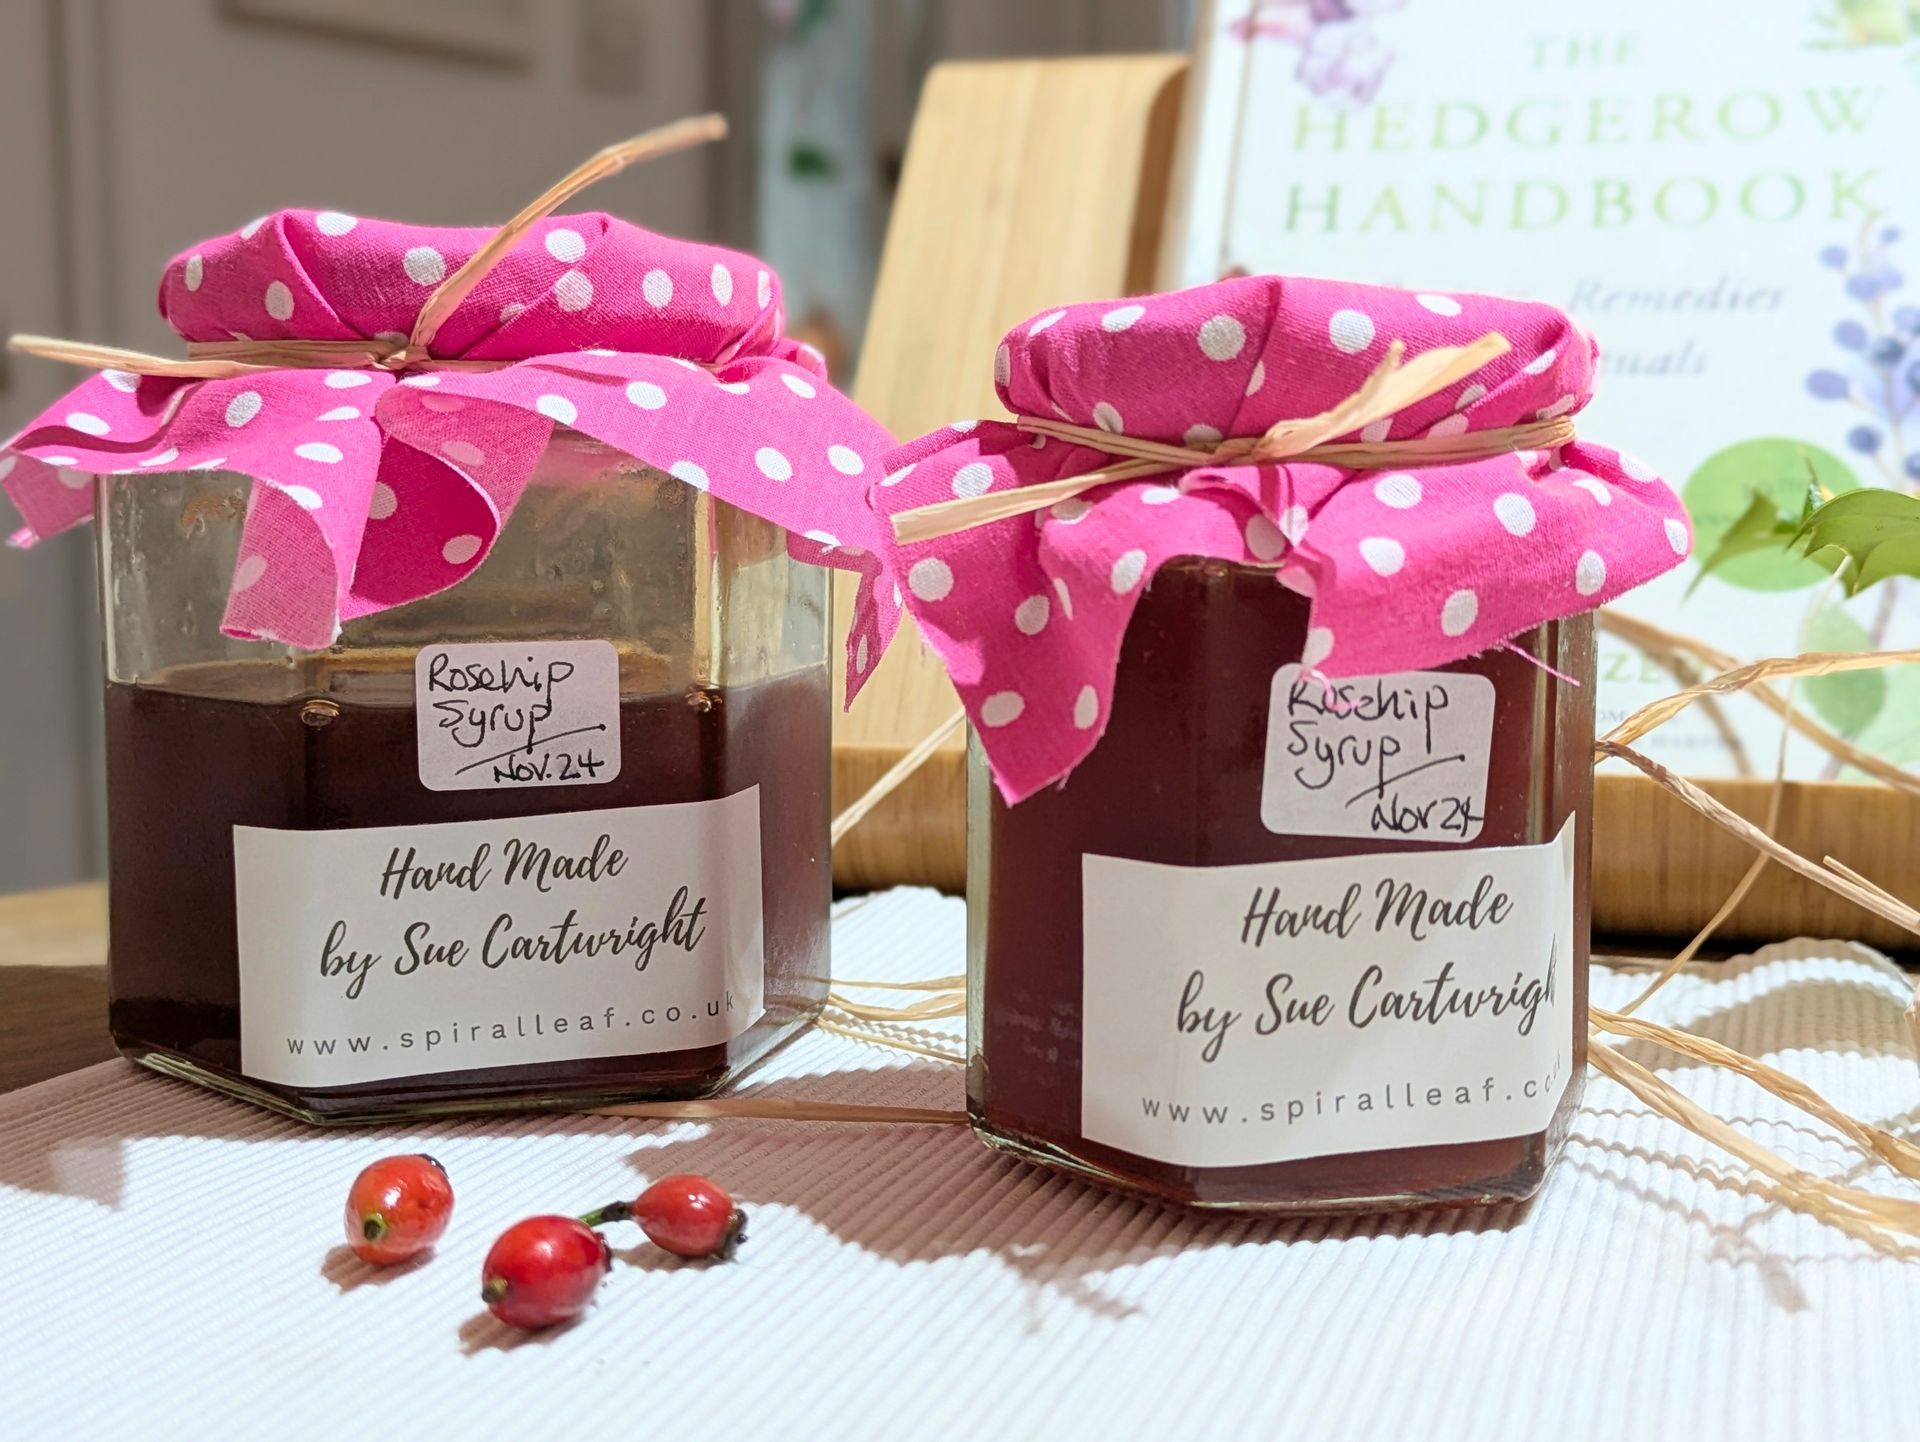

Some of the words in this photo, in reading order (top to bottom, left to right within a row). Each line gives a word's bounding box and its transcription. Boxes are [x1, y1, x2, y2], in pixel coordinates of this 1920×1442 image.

[1527, 33, 1645, 70] THE
[1290, 85, 1887, 154] HEDGEROW
[1282, 167, 1886, 235] HANDBOOK
[1567, 273, 1786, 316] Remedies
[428, 652, 575, 712] Rosehip
[1287, 677, 1449, 755] Rosehip
[432, 699, 553, 756] Syrup
[1286, 719, 1401, 800] Syrup
[379, 843, 493, 900] Hand
[502, 833, 630, 893] Made
[319, 919, 382, 1000] by
[393, 921, 471, 976] Sue
[481, 885, 708, 972] Cartwright
[1240, 885, 1364, 948] Hand
[1374, 874, 1514, 942] Made
[285, 990, 735, 1056] www.spiralleaf.co.uk
[1177, 969, 1242, 1063] by
[1254, 972, 1336, 1037] Sue
